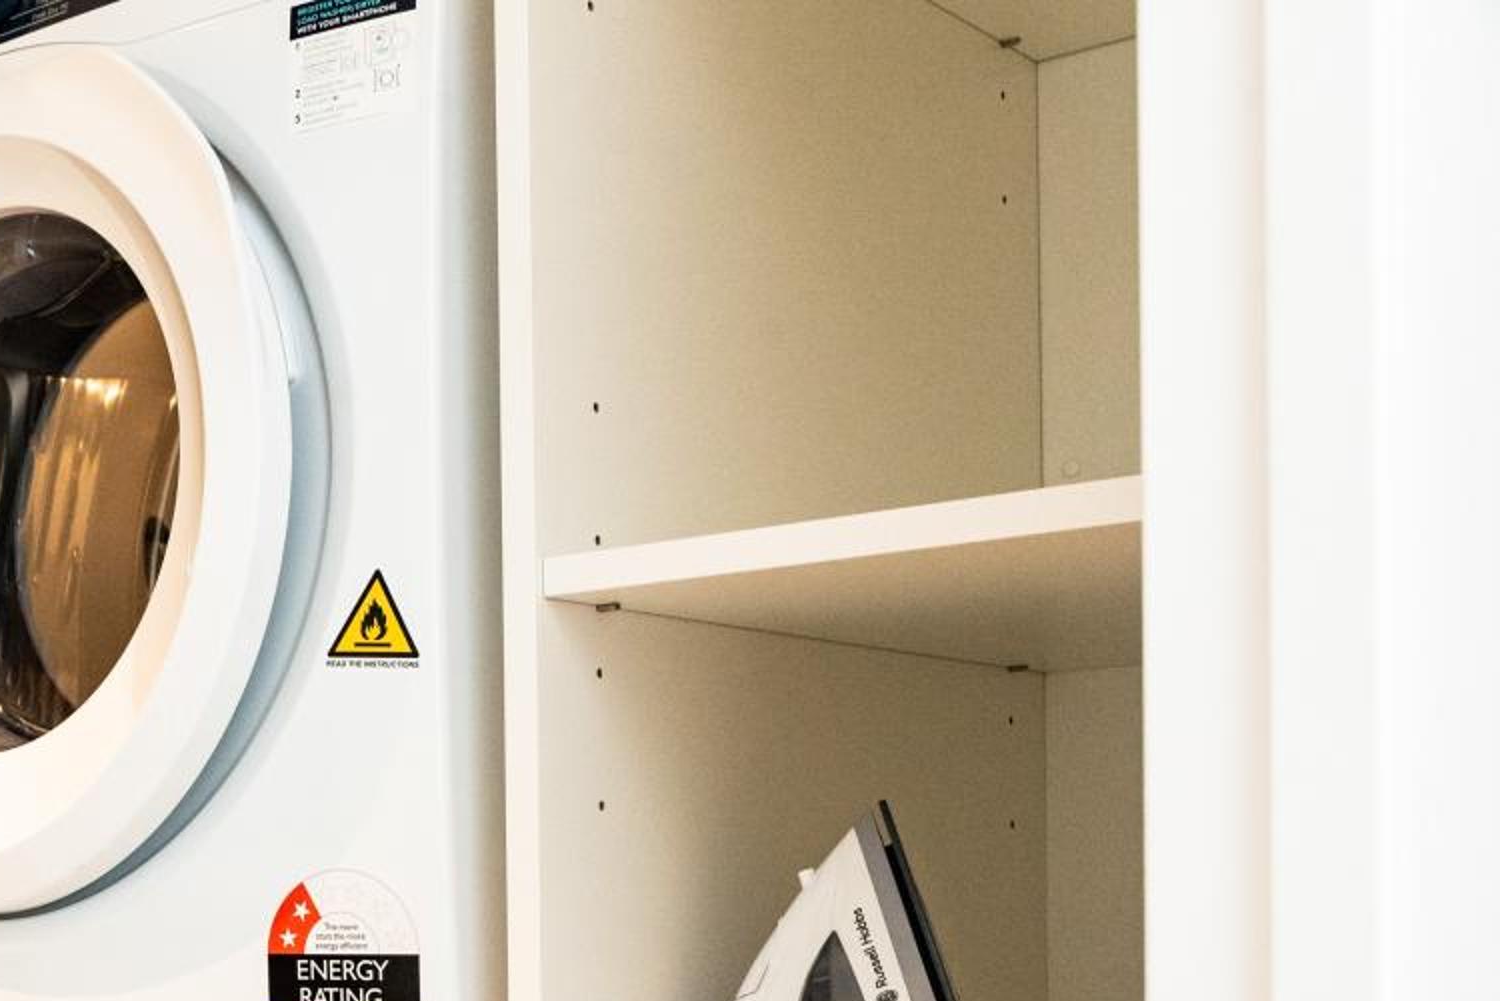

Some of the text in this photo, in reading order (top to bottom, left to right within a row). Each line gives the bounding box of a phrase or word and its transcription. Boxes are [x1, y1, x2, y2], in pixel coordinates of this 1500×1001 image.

[318, 16, 341, 28] YOUR
[342, 2, 397, 23] SMARTPHONE
[363, 660, 419, 669] INSTRUCTIONS
[853, 907, 889, 989] Russell Hobbs
[297, 958, 389, 982] ENERGY
